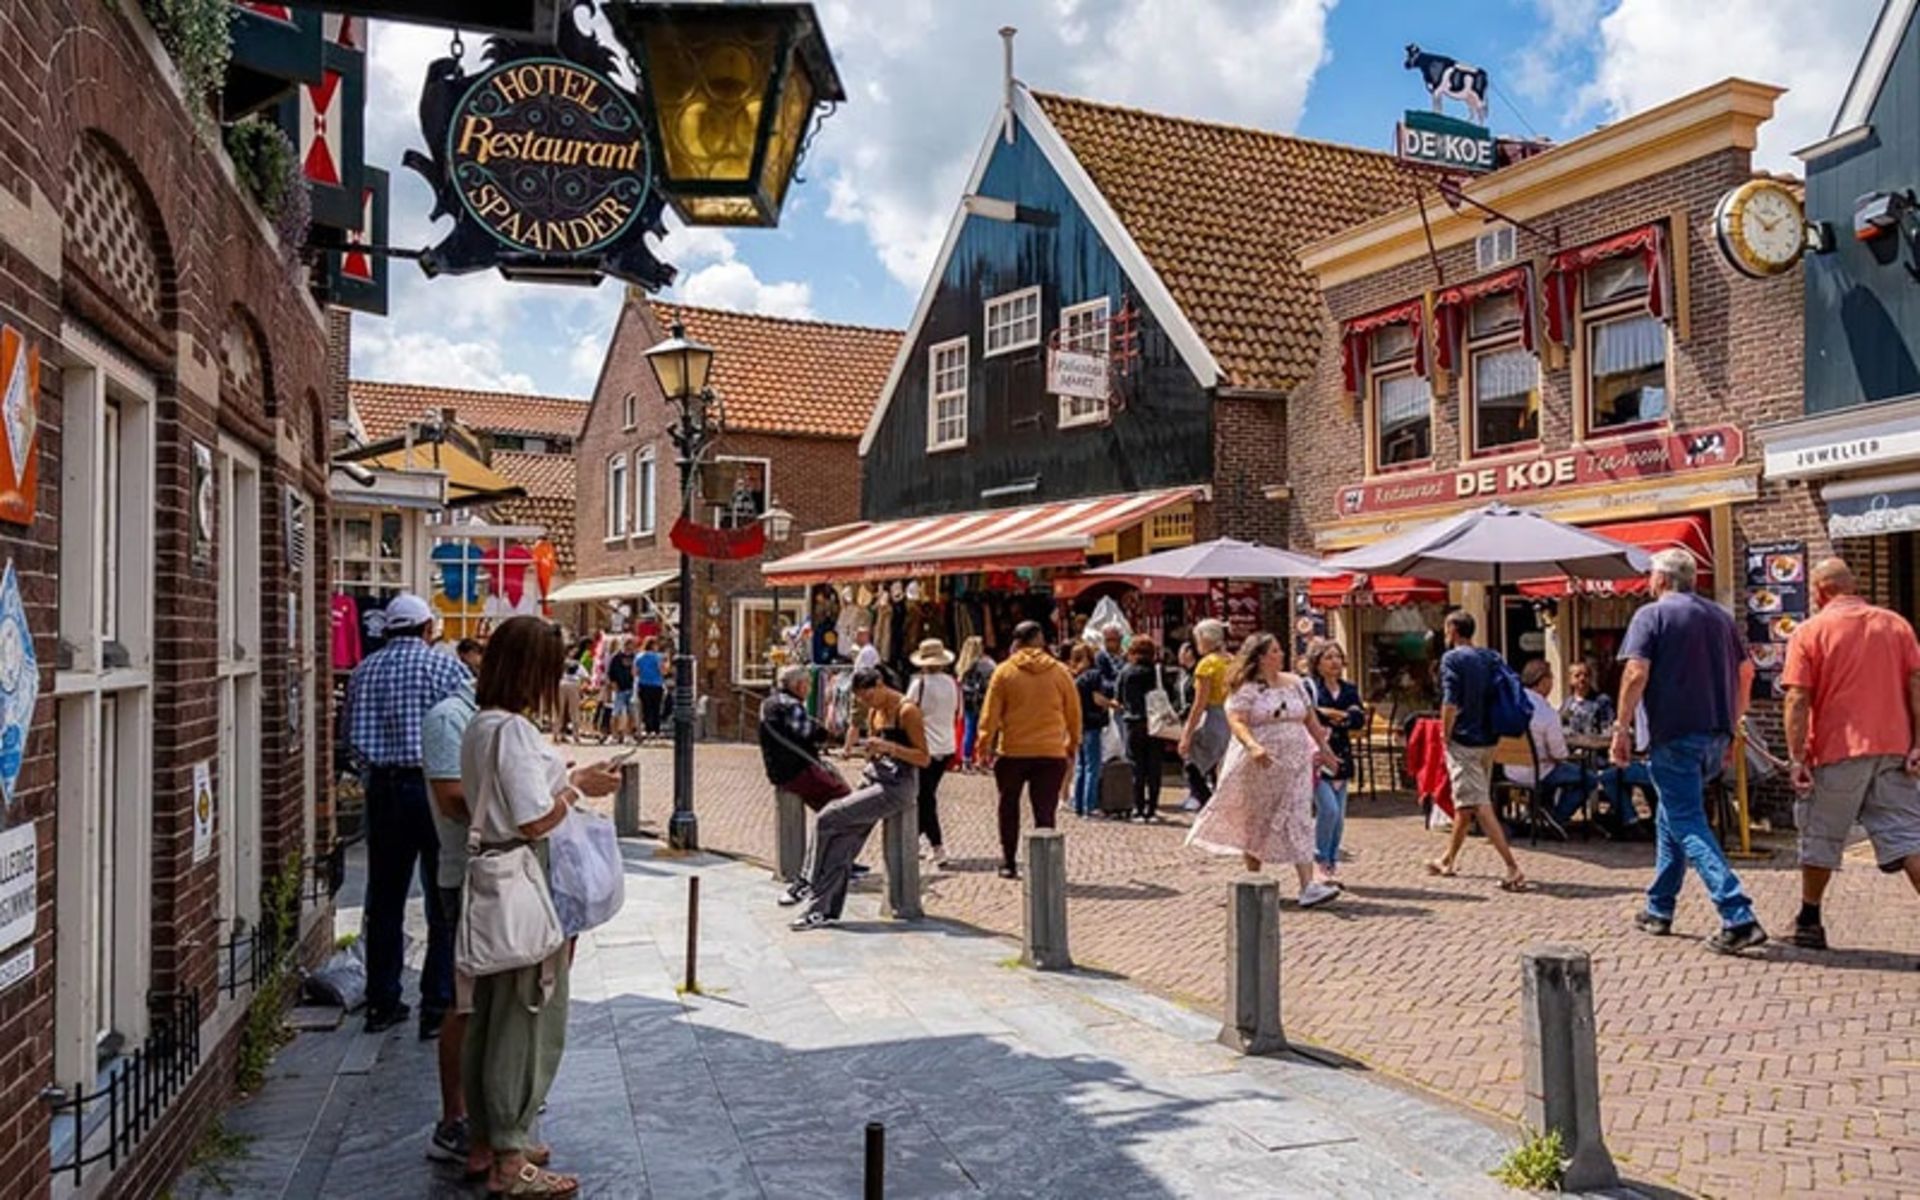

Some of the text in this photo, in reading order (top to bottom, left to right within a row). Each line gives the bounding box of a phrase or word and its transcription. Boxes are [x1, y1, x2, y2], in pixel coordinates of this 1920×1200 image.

[494, 65, 599, 112] HOTEL
[459, 116, 640, 170] Restaurant
[1405, 130, 1493, 165] DE KOE
[469, 184, 631, 250] SPAANDER
[1374, 480, 1443, 504] Restaurant
[1456, 469, 1498, 497] DE
[1506, 457, 1577, 490] KOE
